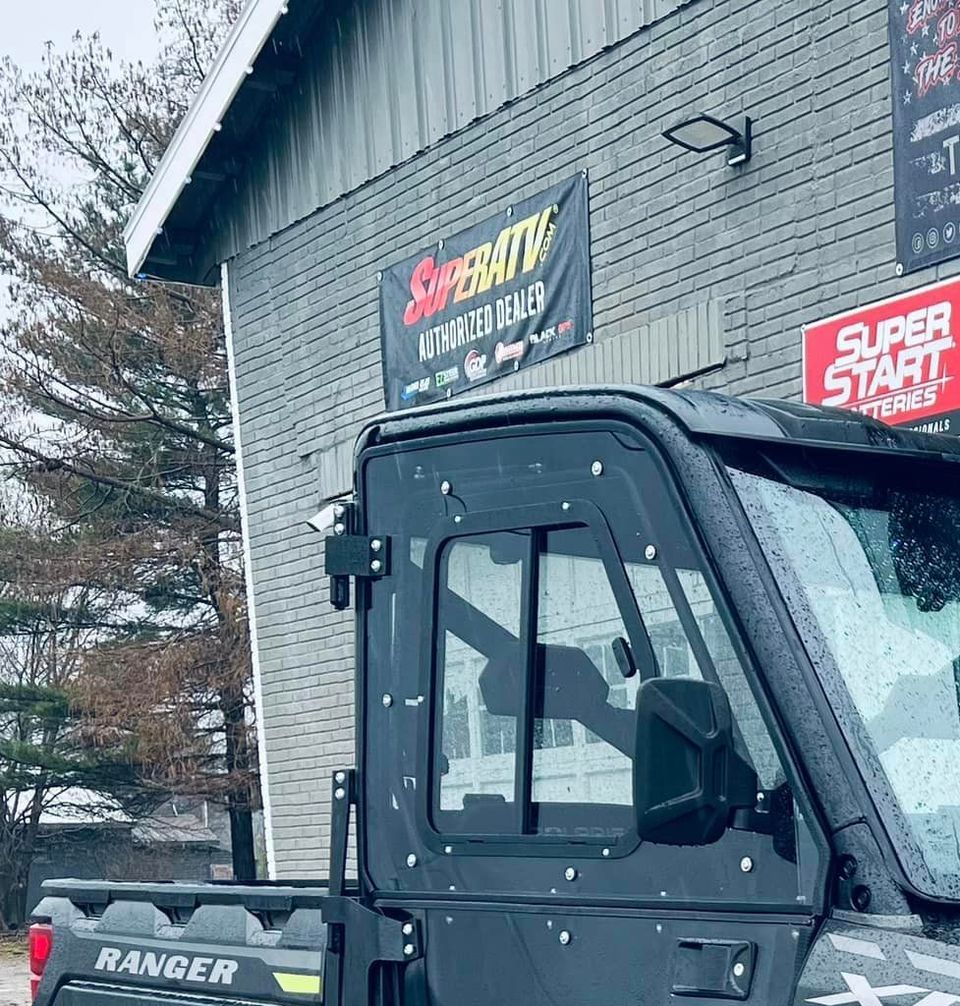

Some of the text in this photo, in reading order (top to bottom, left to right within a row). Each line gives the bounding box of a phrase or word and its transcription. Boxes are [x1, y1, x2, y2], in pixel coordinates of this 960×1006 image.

[940, 11, 956, 41] TO
[917, 45, 955, 88] THE
[418, 303, 493, 362] AUTHORIZED
[496, 280, 546, 330] DEALER
[834, 301, 952, 368] SUPER
[821, 336, 953, 407] START
[850, 386, 938, 420] TTERIES
[94, 947, 240, 985] RANGER
